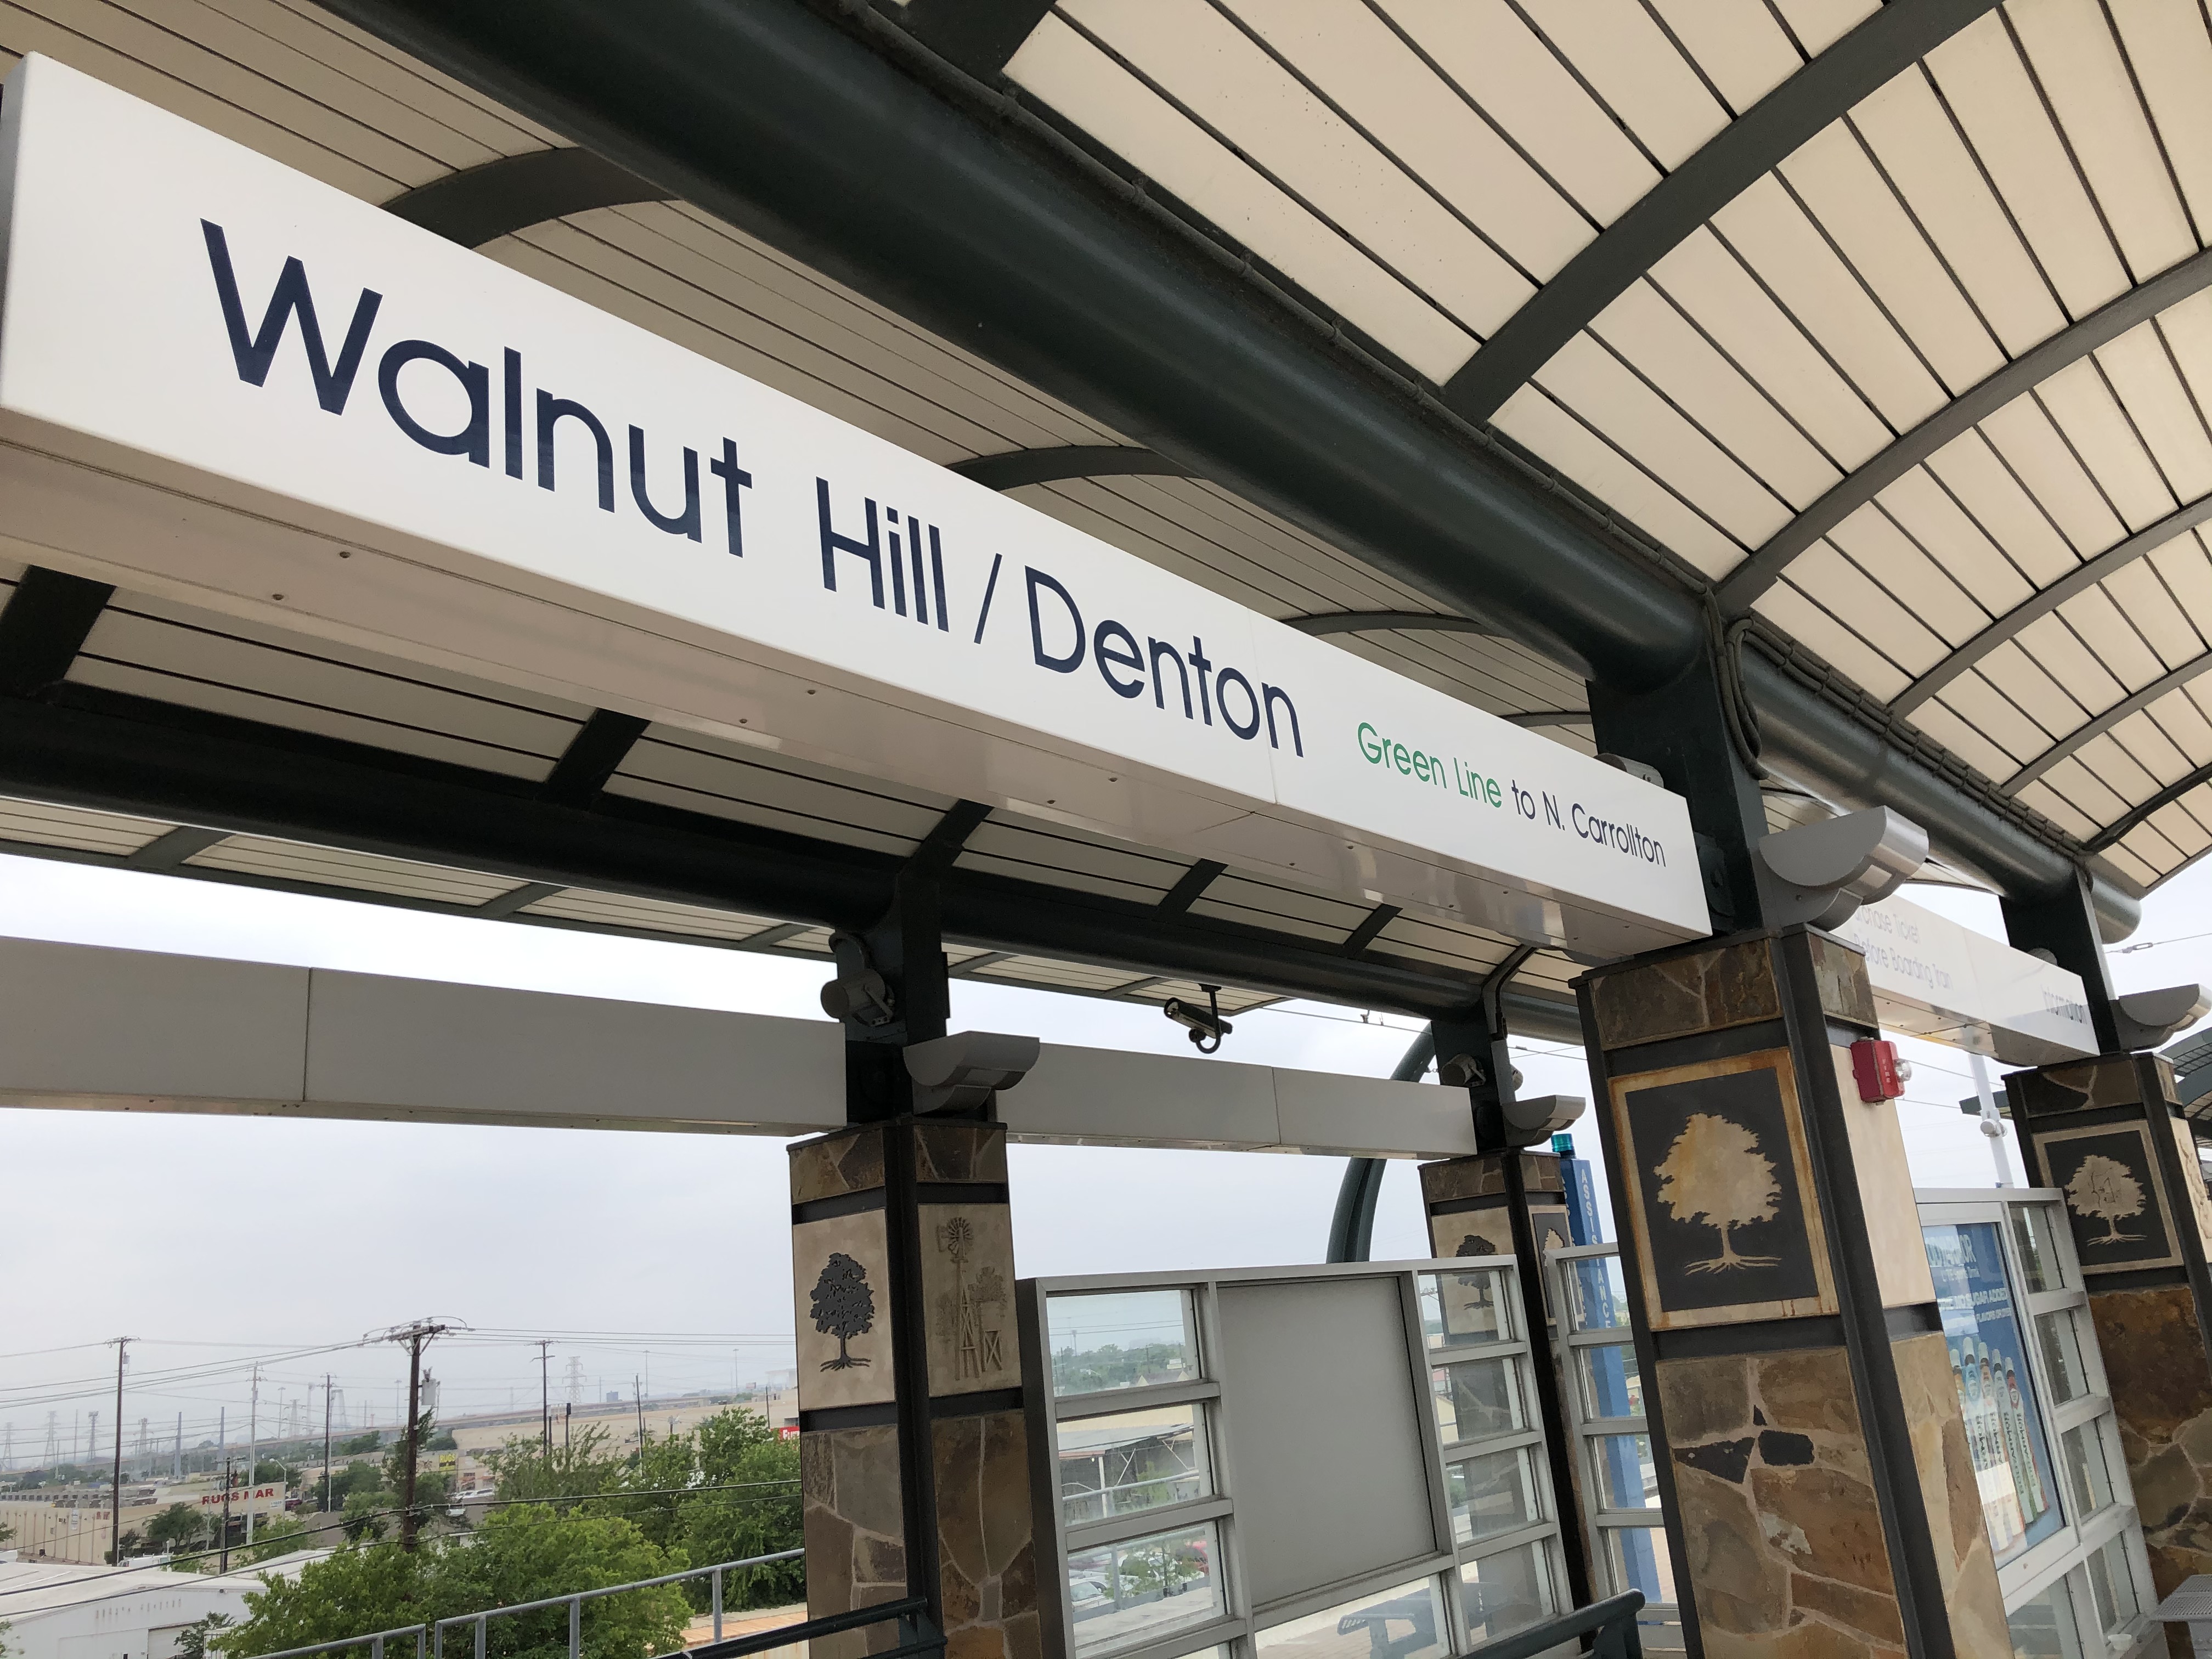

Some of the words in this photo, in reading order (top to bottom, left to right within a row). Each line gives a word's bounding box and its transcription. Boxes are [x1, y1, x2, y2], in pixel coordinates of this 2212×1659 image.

[200, 218, 752, 558] Walnut
[816, 477, 949, 632] Hill
[1025, 566, 1304, 758] Denton
[1358, 722, 1447, 789] Green
[1453, 757, 1502, 808] Line
[1511, 780, 1536, 820] to
[1542, 791, 1565, 831] N.
[1572, 803, 1666, 867] Carrollton
[1855, 906, 1892, 933] urchase
[1893, 913, 1920, 944] Ticket
[1889, 947, 1934, 989] Boarding
